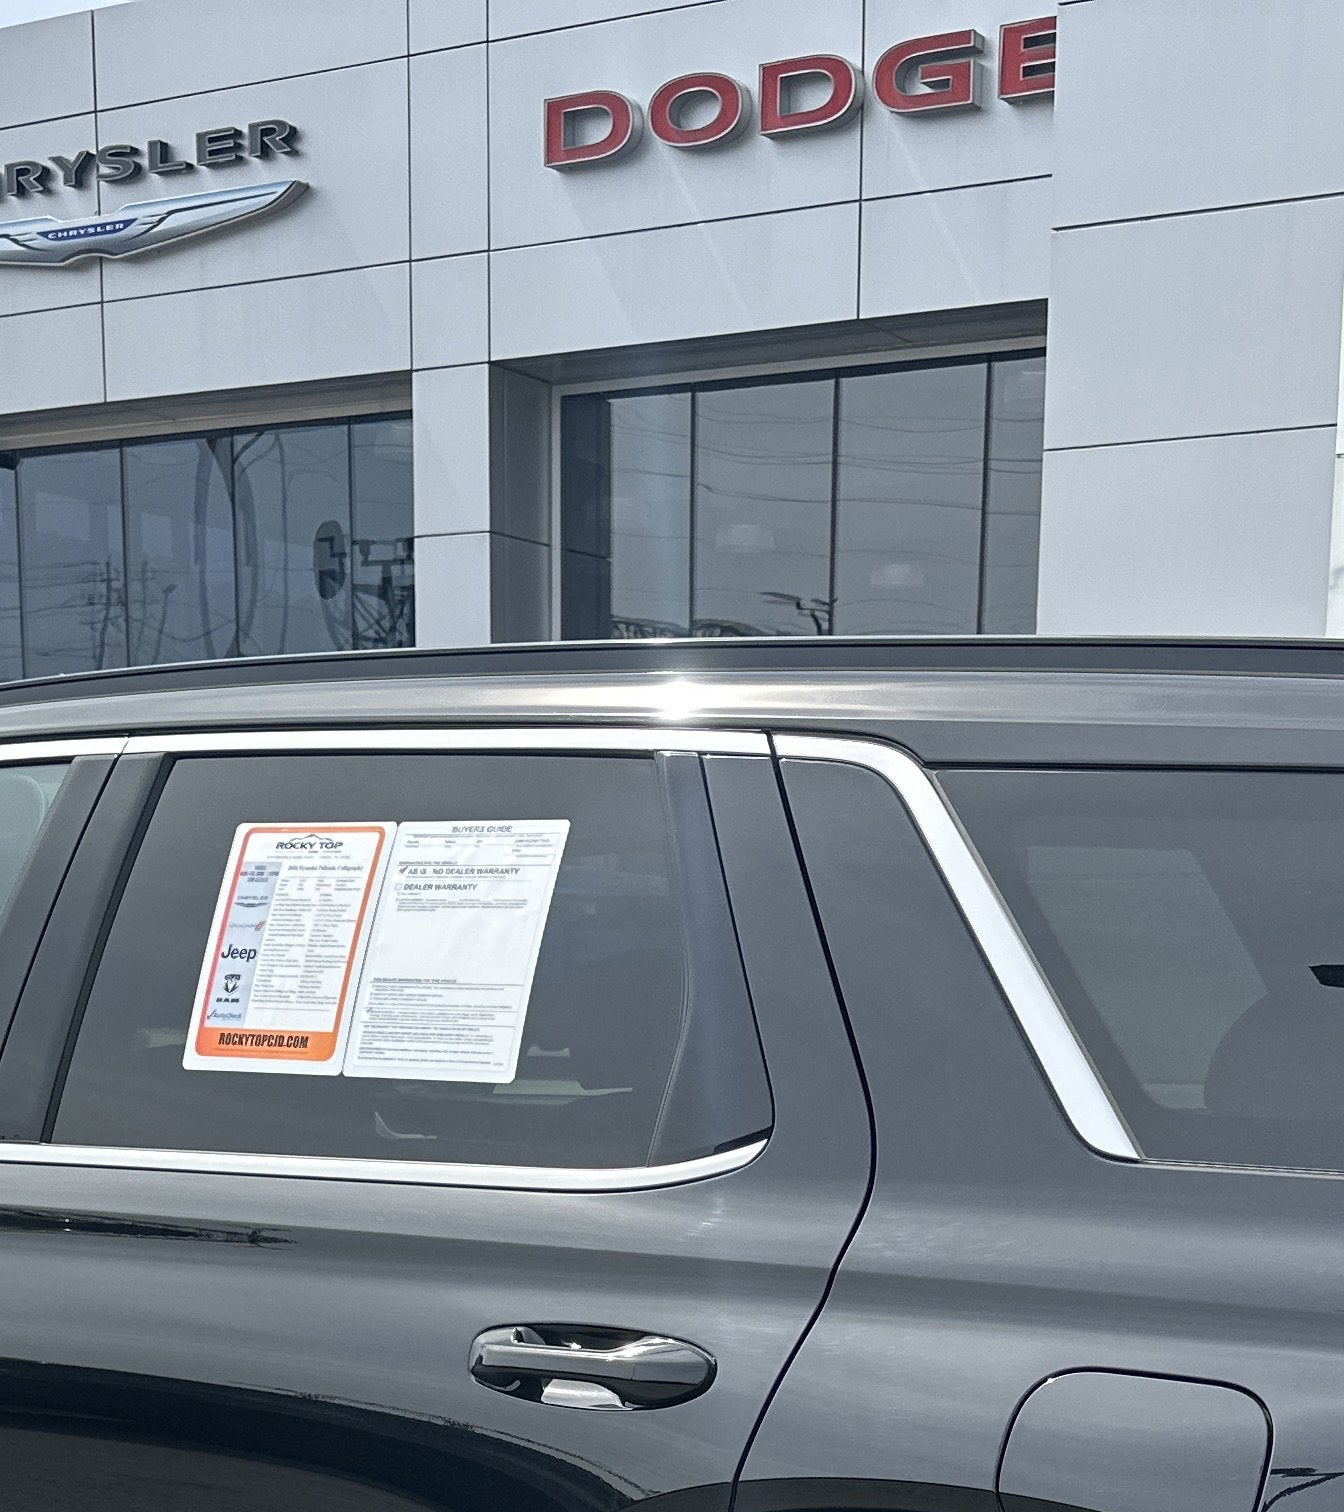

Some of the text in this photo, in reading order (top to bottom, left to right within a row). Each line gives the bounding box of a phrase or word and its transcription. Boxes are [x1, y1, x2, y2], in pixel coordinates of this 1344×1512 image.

[544, 15, 1056, 172] DODGE
[47, 221, 125, 241] CHRYSLER
[275, 841, 344, 850] ROCKY TOP
[476, 867, 521, 876] WARRANTY
[434, 883, 478, 891] WARRANTY
[221, 944, 257, 963] Jeep
[218, 1032, 309, 1049] ROCKYTOPCJD.COM
